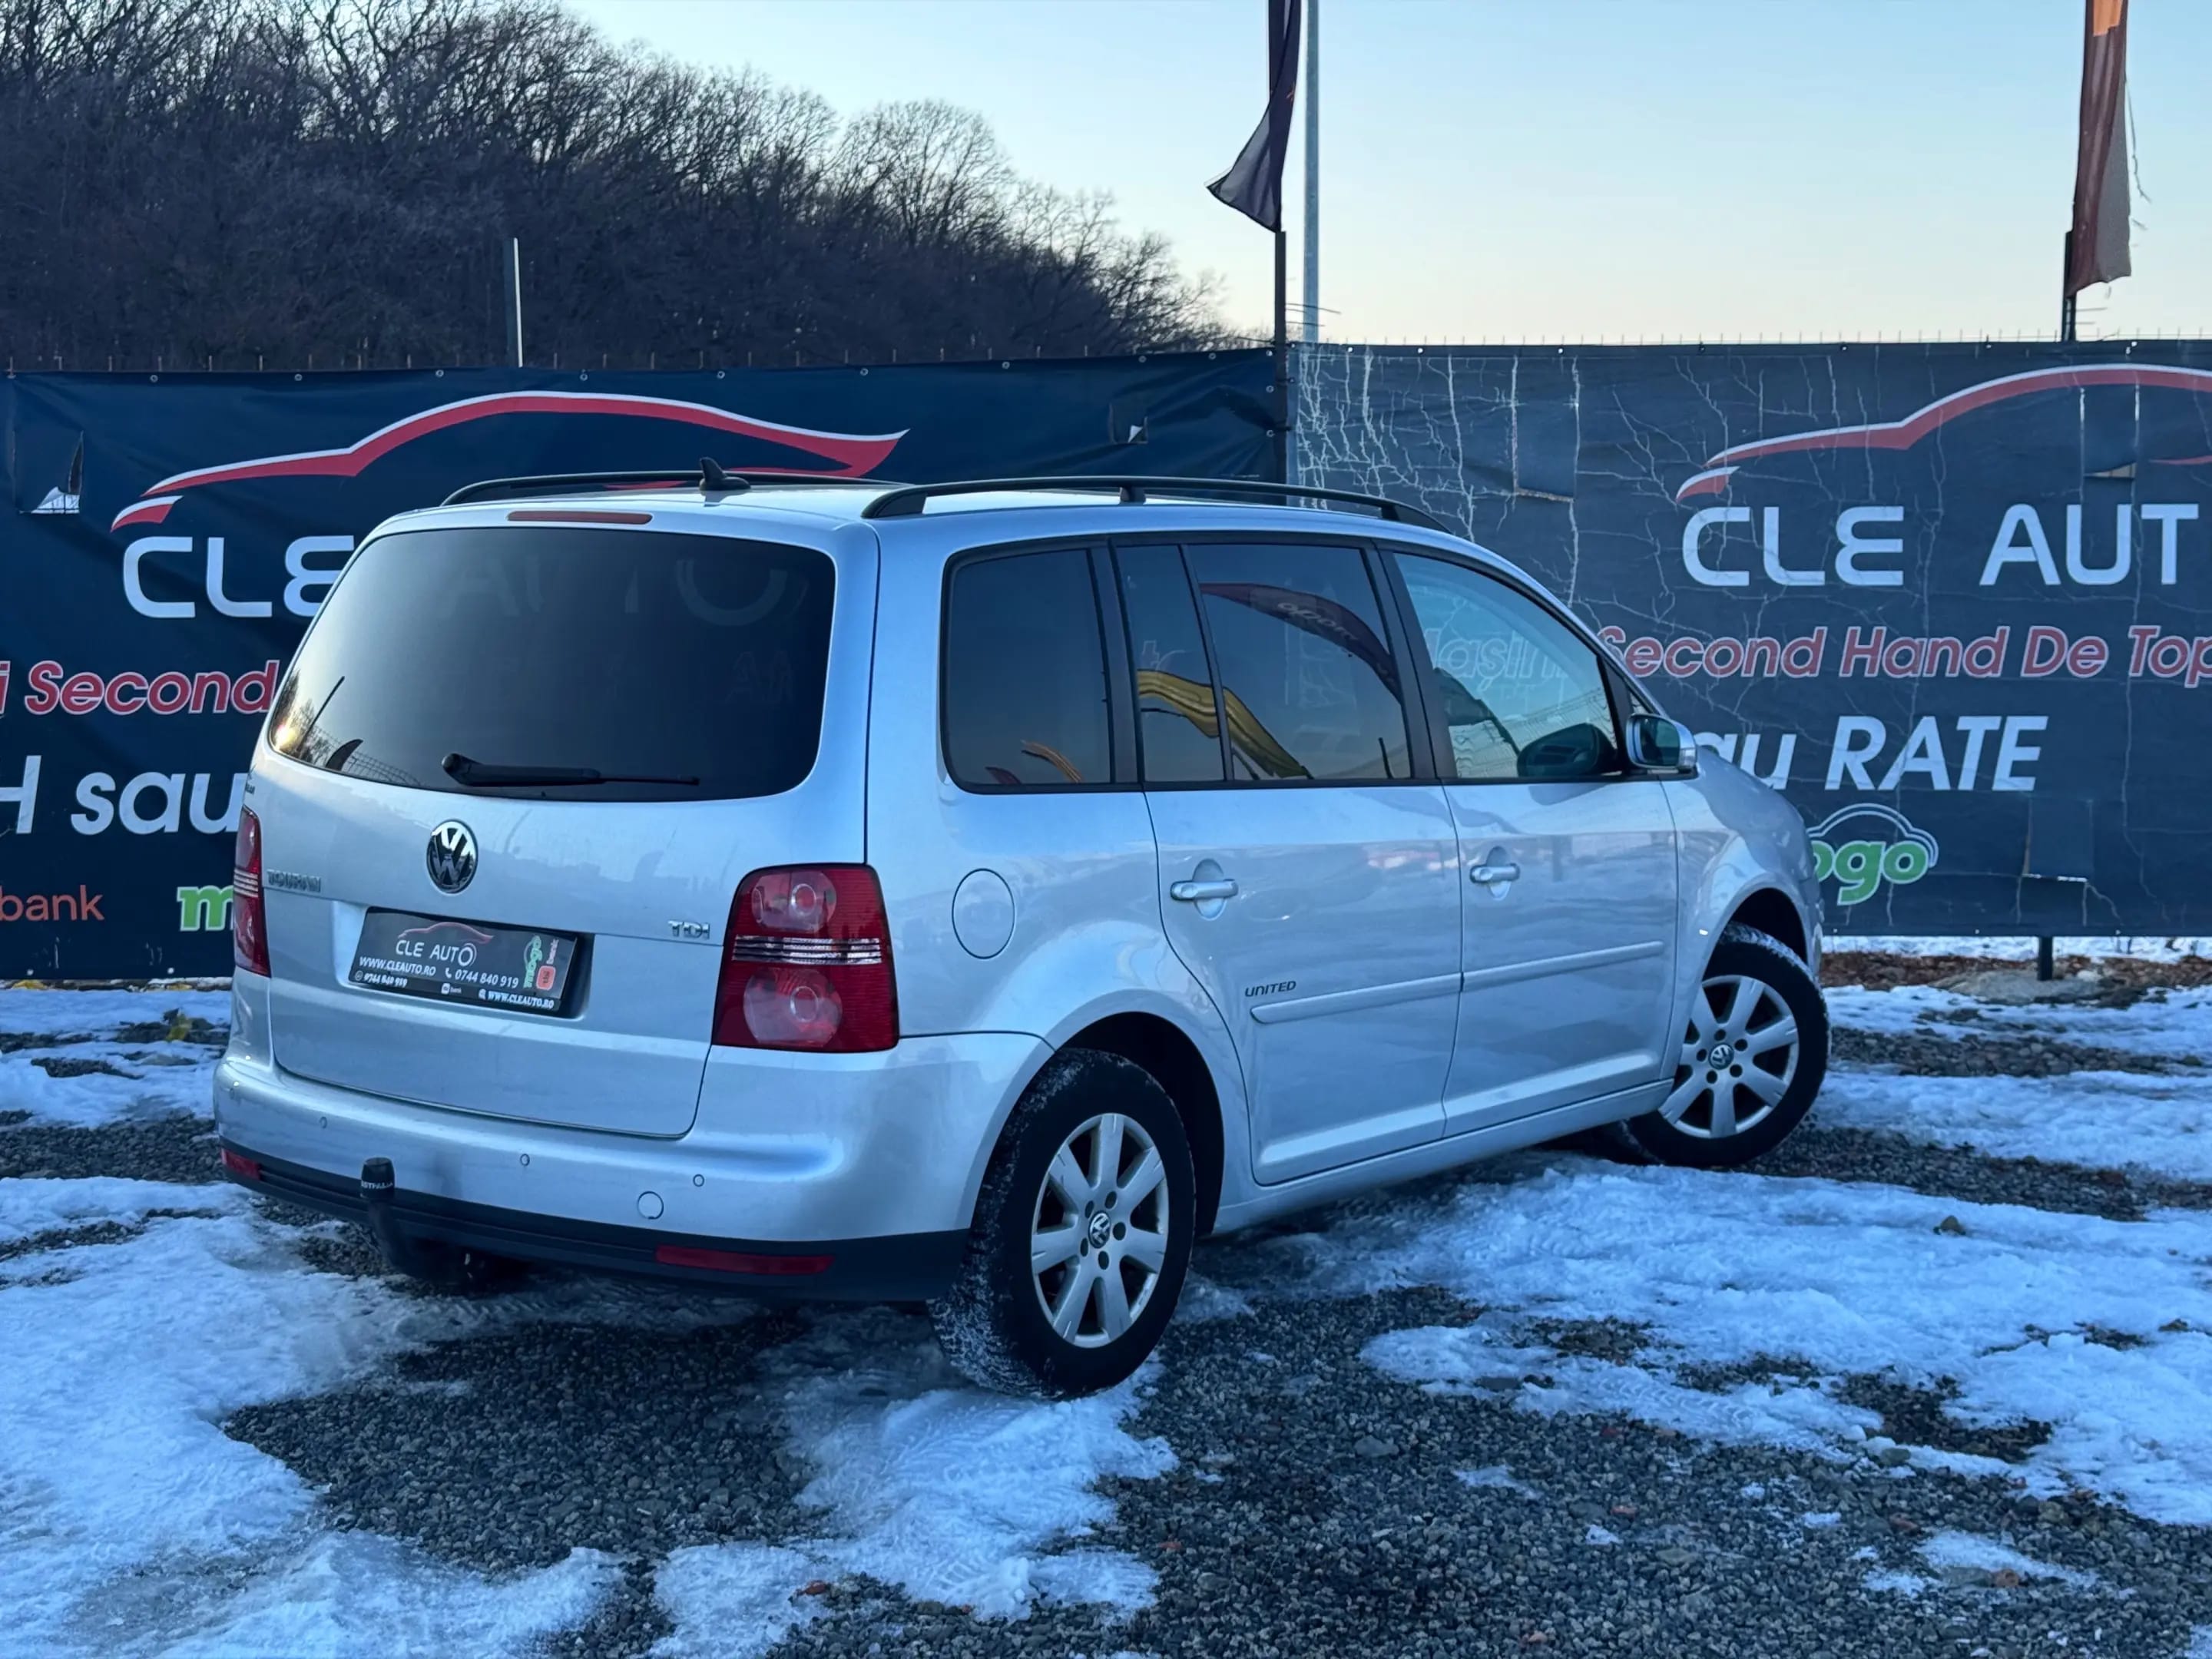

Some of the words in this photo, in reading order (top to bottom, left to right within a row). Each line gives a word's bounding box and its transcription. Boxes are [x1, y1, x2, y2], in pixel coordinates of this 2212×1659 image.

[1682, 506, 1904, 586] CLE
[123, 535, 354, 618] CLE
[1839, 625, 2010, 678] Hand
[2020, 625, 2109, 678] De
[2128, 624, 2212, 688] Top
[25, 660, 280, 715] Second
[1824, 715, 2049, 790] RATE
[71, 771, 248, 835] sau
[396, 939, 425, 958] CLE
[429, 944, 475, 967] AUTO
[667, 920, 710, 939] TDI
[359, 956, 437, 977] WWW.CLEAUTO.RO
[455, 969, 479, 983] 0744
[479, 972, 499, 986] 840
[499, 975, 519, 989] 919
[1245, 980, 1296, 997] UNITED
